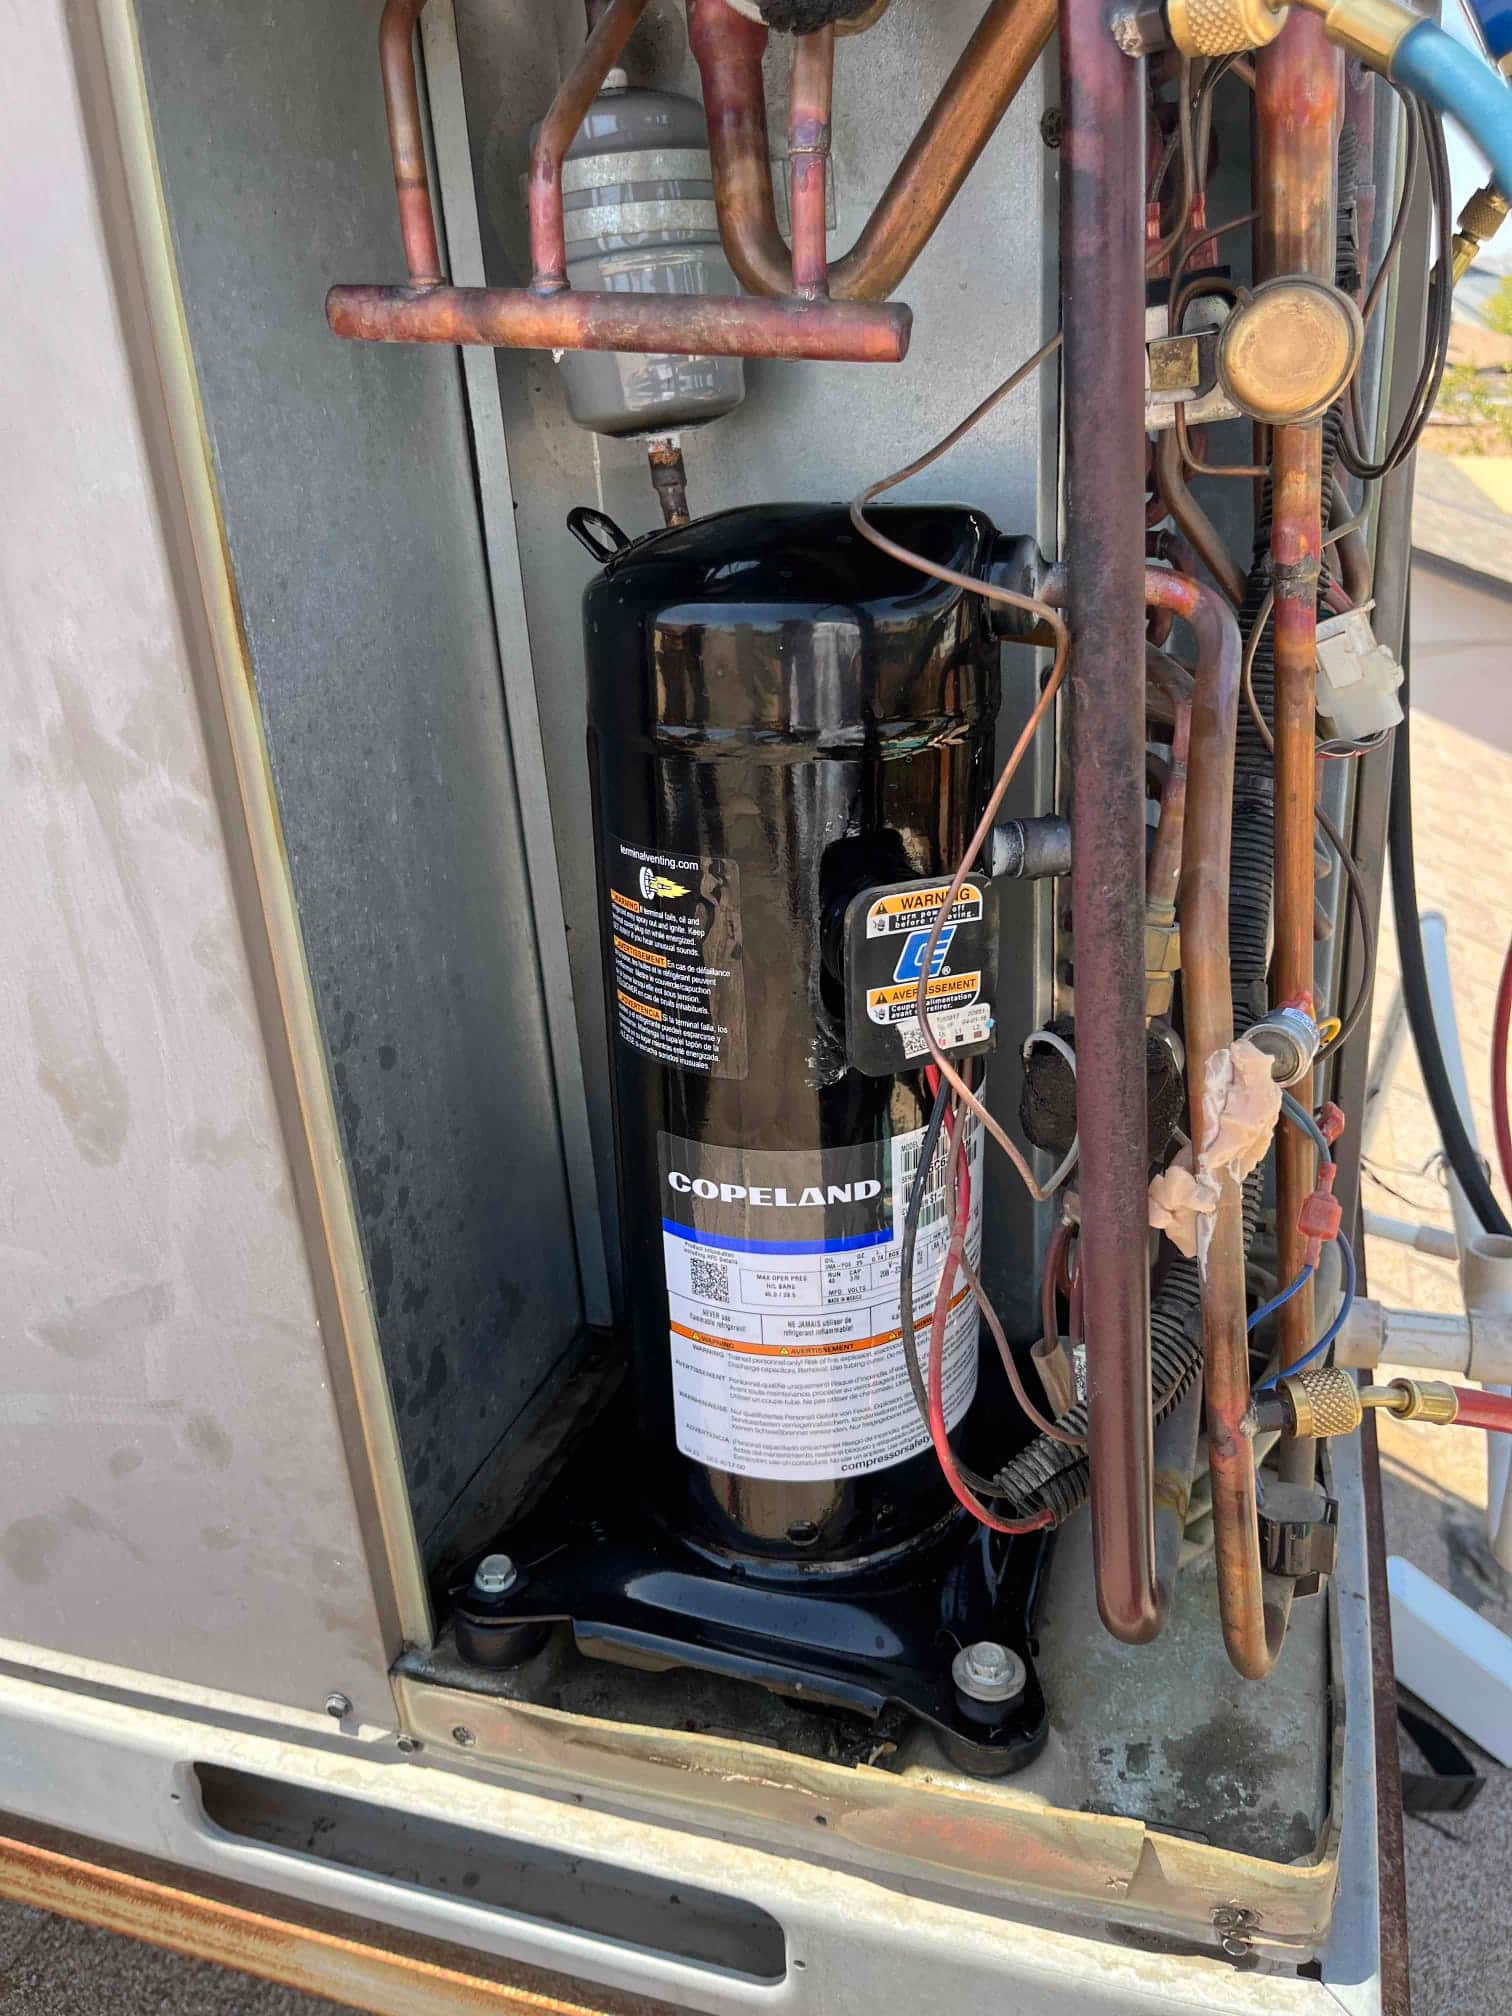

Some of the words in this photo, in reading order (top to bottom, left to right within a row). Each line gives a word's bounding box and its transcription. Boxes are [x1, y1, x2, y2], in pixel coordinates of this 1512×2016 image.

[901, 888, 970, 909] WARNG
[896, 912, 917, 922] Turn
[667, 1171, 882, 1207] COPELAND
